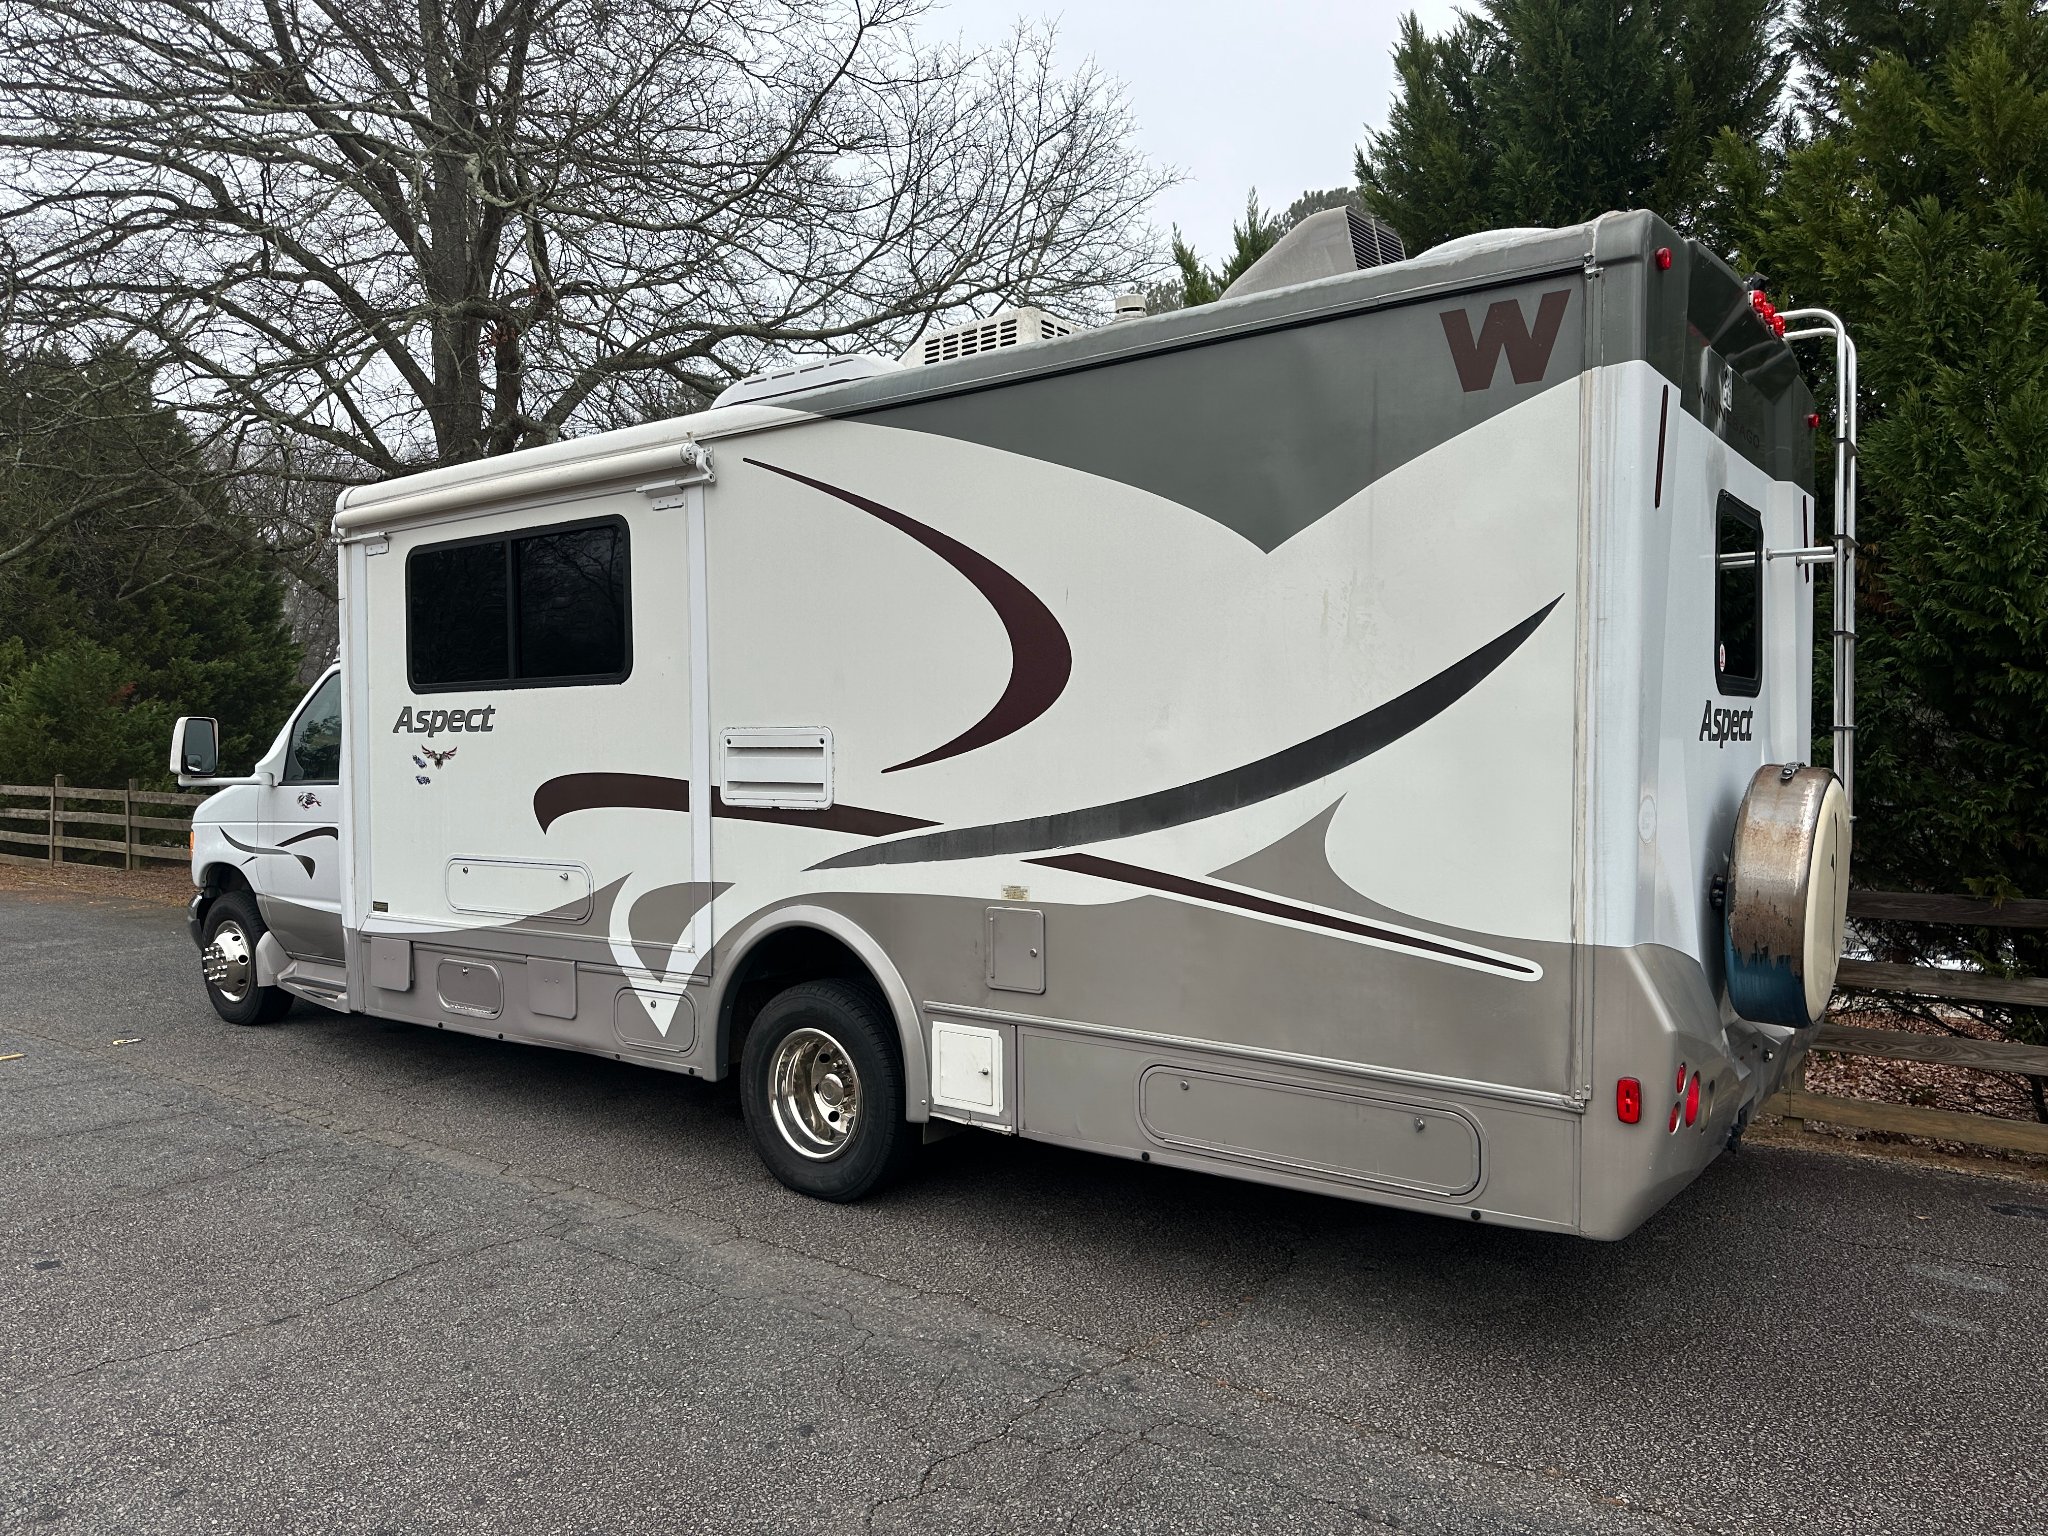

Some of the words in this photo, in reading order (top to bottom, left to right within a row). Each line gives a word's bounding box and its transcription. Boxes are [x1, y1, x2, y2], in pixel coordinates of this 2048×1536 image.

[1439, 289, 1571, 393] W
[1695, 382, 1760, 449] WINNEBAGO
[393, 704, 496, 738] Aspect
[1699, 700, 1753, 748] Aspect
